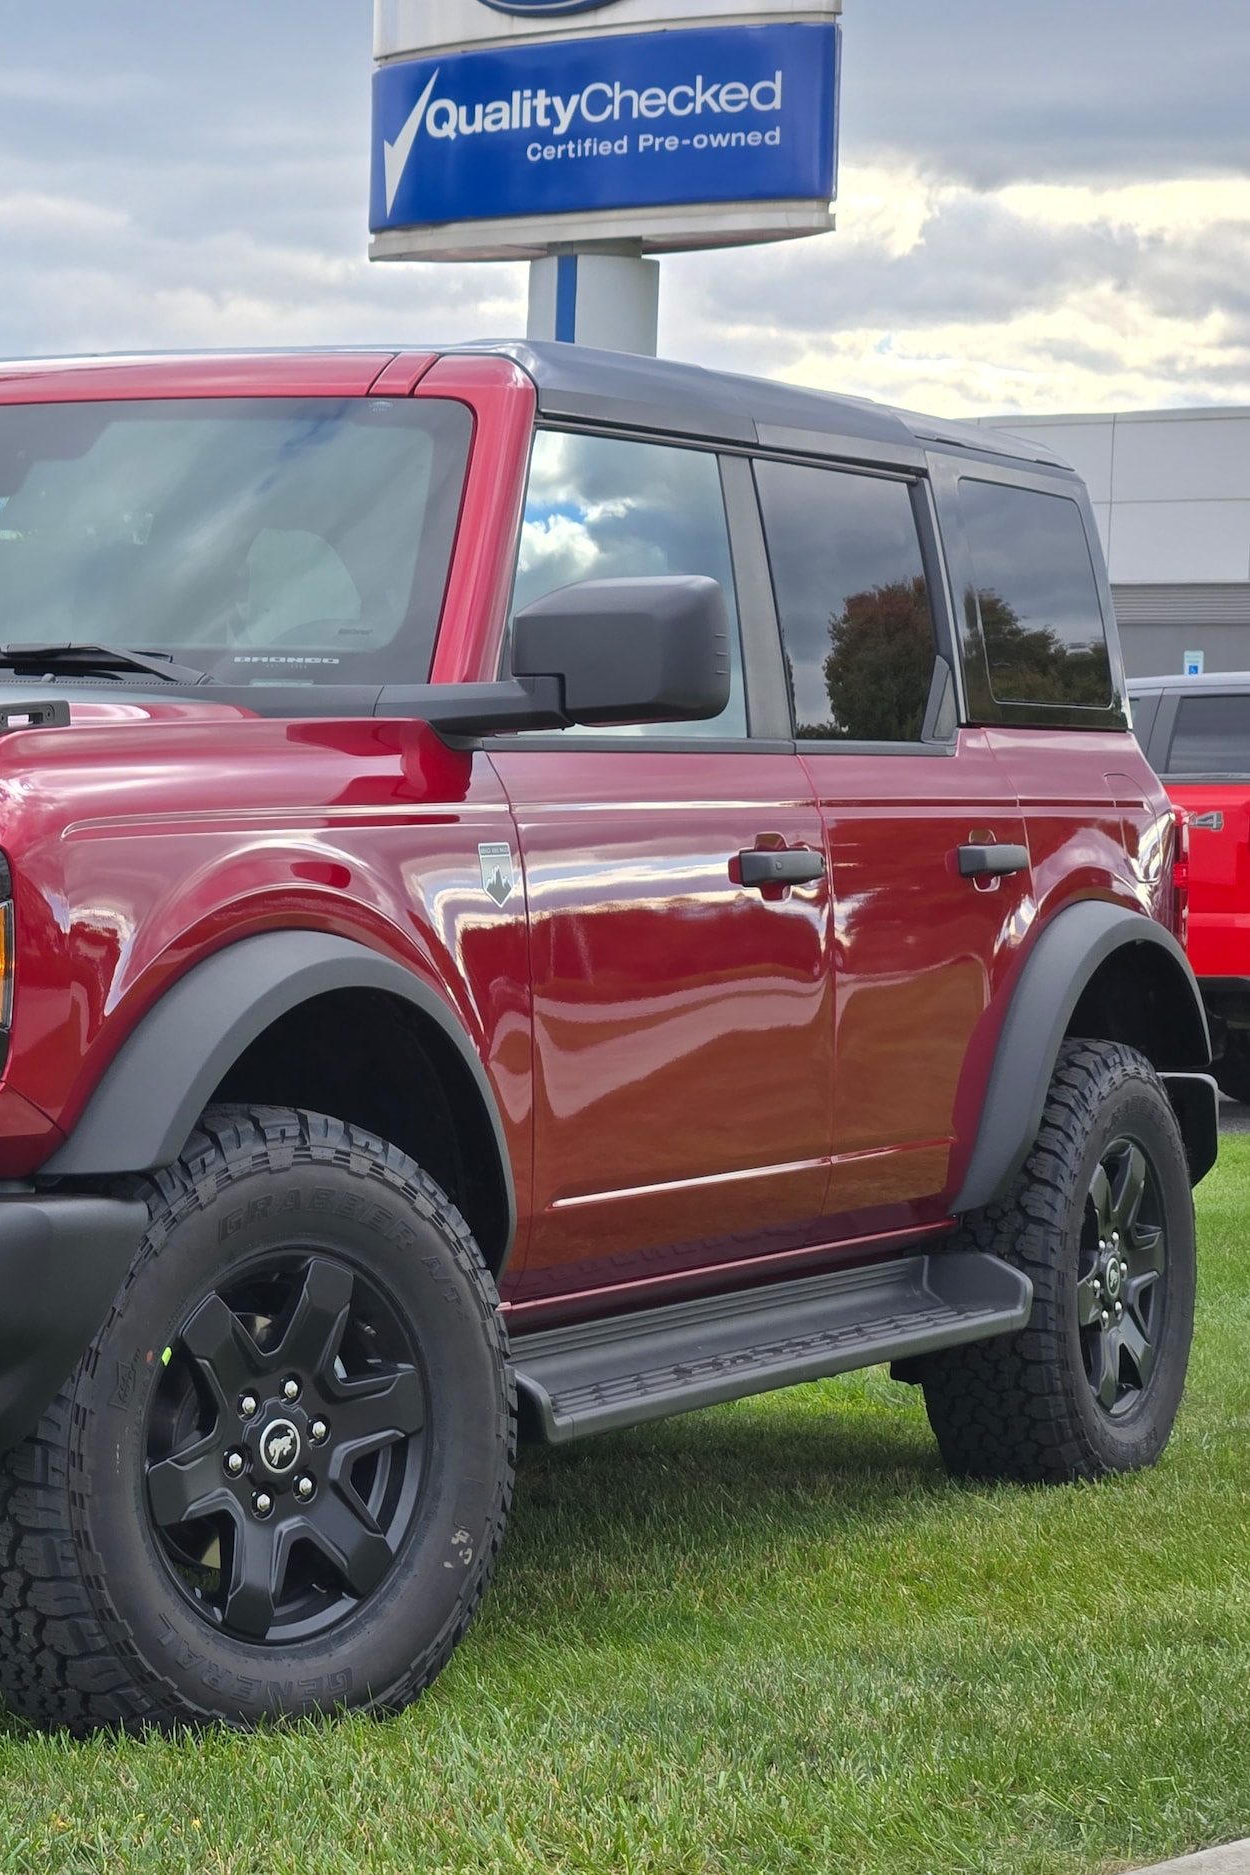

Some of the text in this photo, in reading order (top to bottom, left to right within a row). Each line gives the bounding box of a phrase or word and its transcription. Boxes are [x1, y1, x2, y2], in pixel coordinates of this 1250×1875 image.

[526, 126, 781, 162] Certified Pre-owned
[234, 656, 340, 665] BRONCO
[217, 1186, 418, 1253] GRABBER
[157, 1611, 354, 1706] GENERAL
